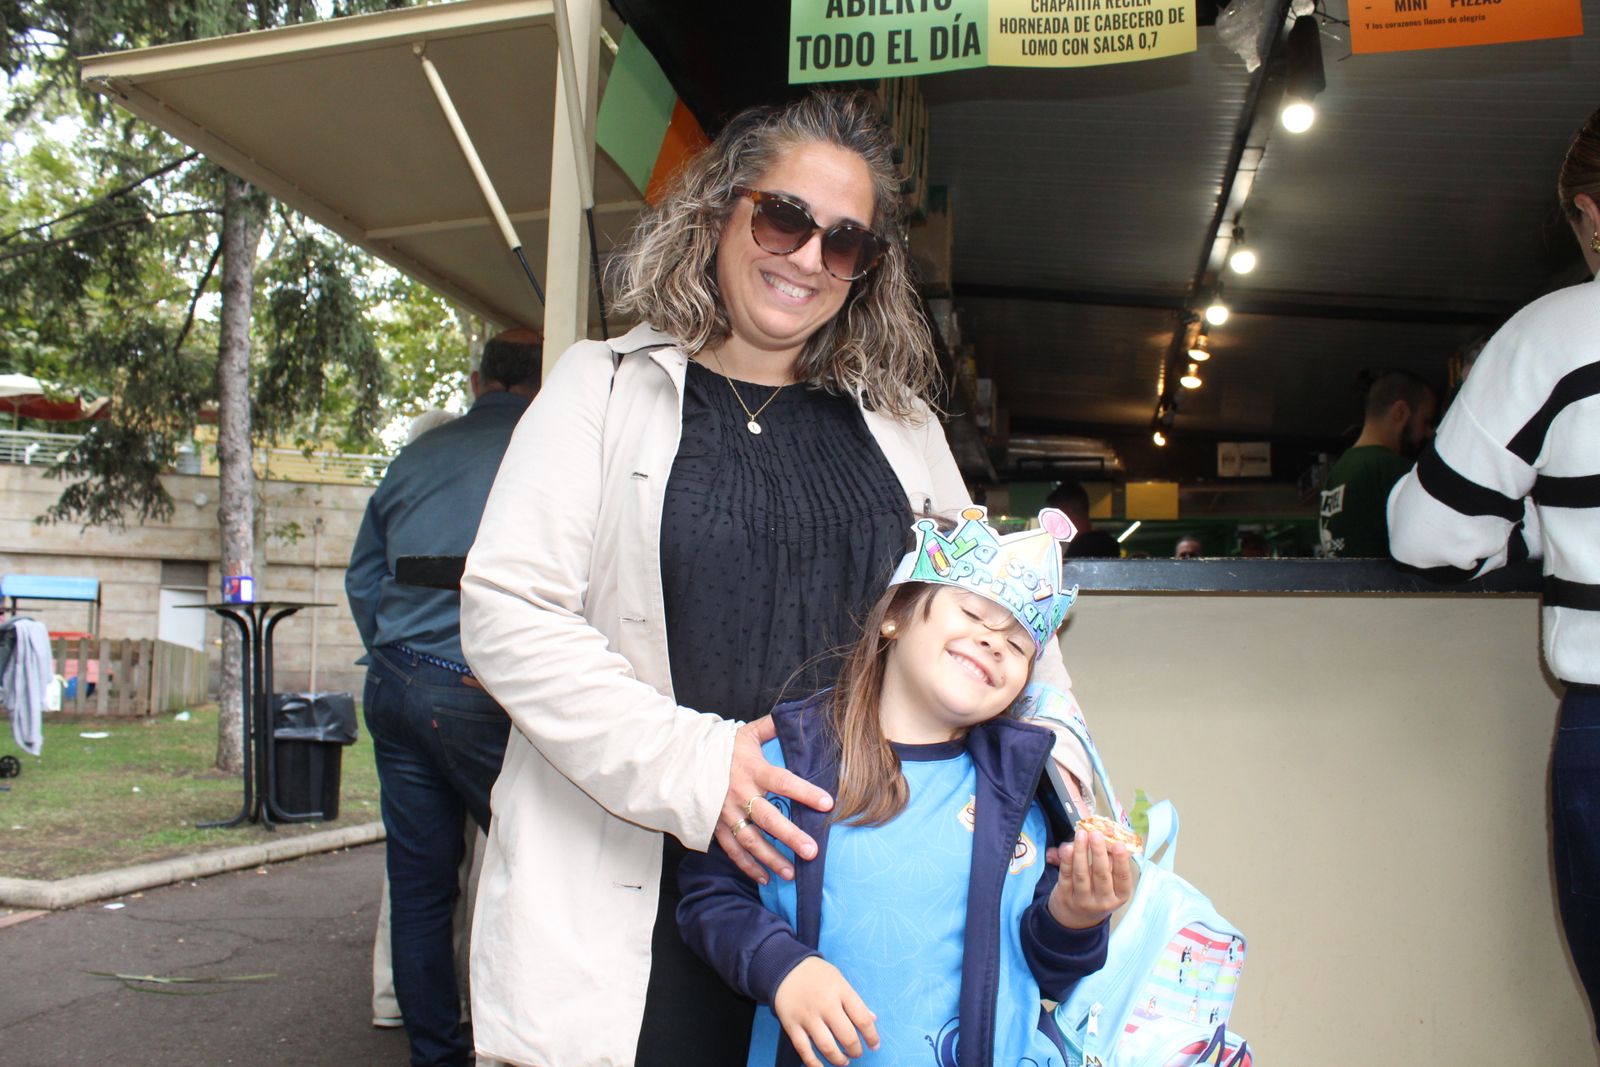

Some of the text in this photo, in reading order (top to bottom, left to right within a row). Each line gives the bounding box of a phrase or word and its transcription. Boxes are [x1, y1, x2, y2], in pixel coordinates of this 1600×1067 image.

[1394, 0, 1428, 13] MINI
[999, 7, 1185, 34] HORNEADA DE CABECERO DE
[1384, 19, 1422, 29] corazones
[1423, 17, 1447, 26] llenos
[1447, 16, 1457, 24] de
[796, 13, 981, 70] TODO EL DÍA
[1021, 31, 1159, 56] LOMO CON SALSA 0,7
